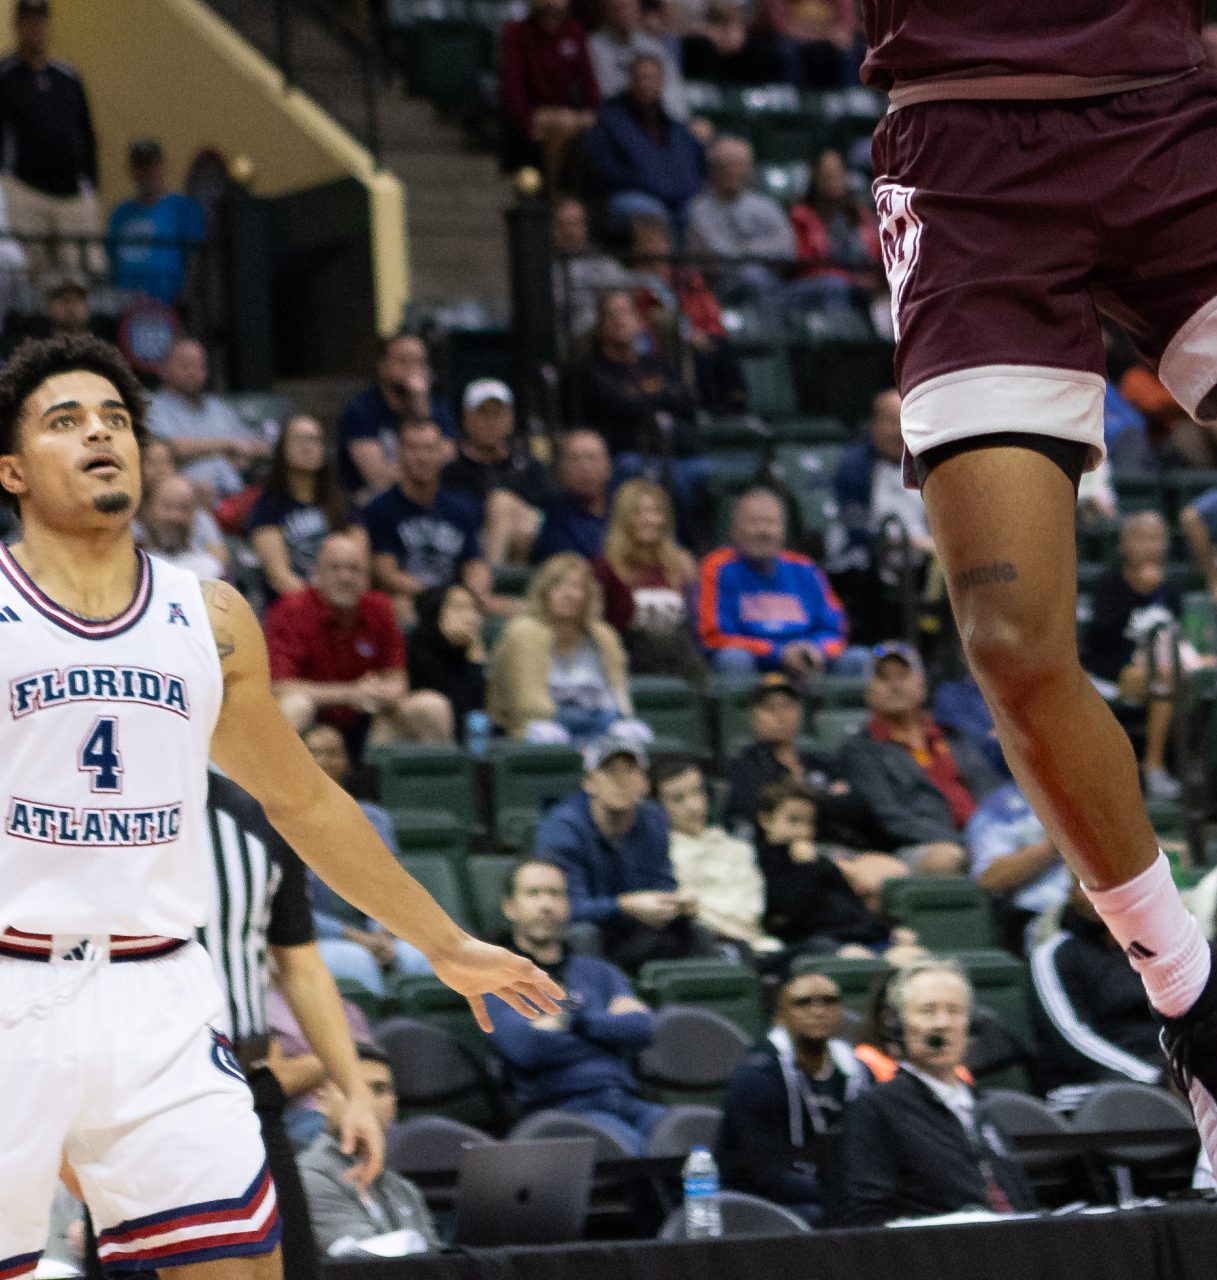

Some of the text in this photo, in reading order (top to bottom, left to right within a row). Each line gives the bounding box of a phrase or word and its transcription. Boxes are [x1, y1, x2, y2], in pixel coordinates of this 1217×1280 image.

[11, 666, 190, 720] FLORIDA
[79, 715, 124, 795] 4
[7, 797, 183, 847] ATLANTIC
